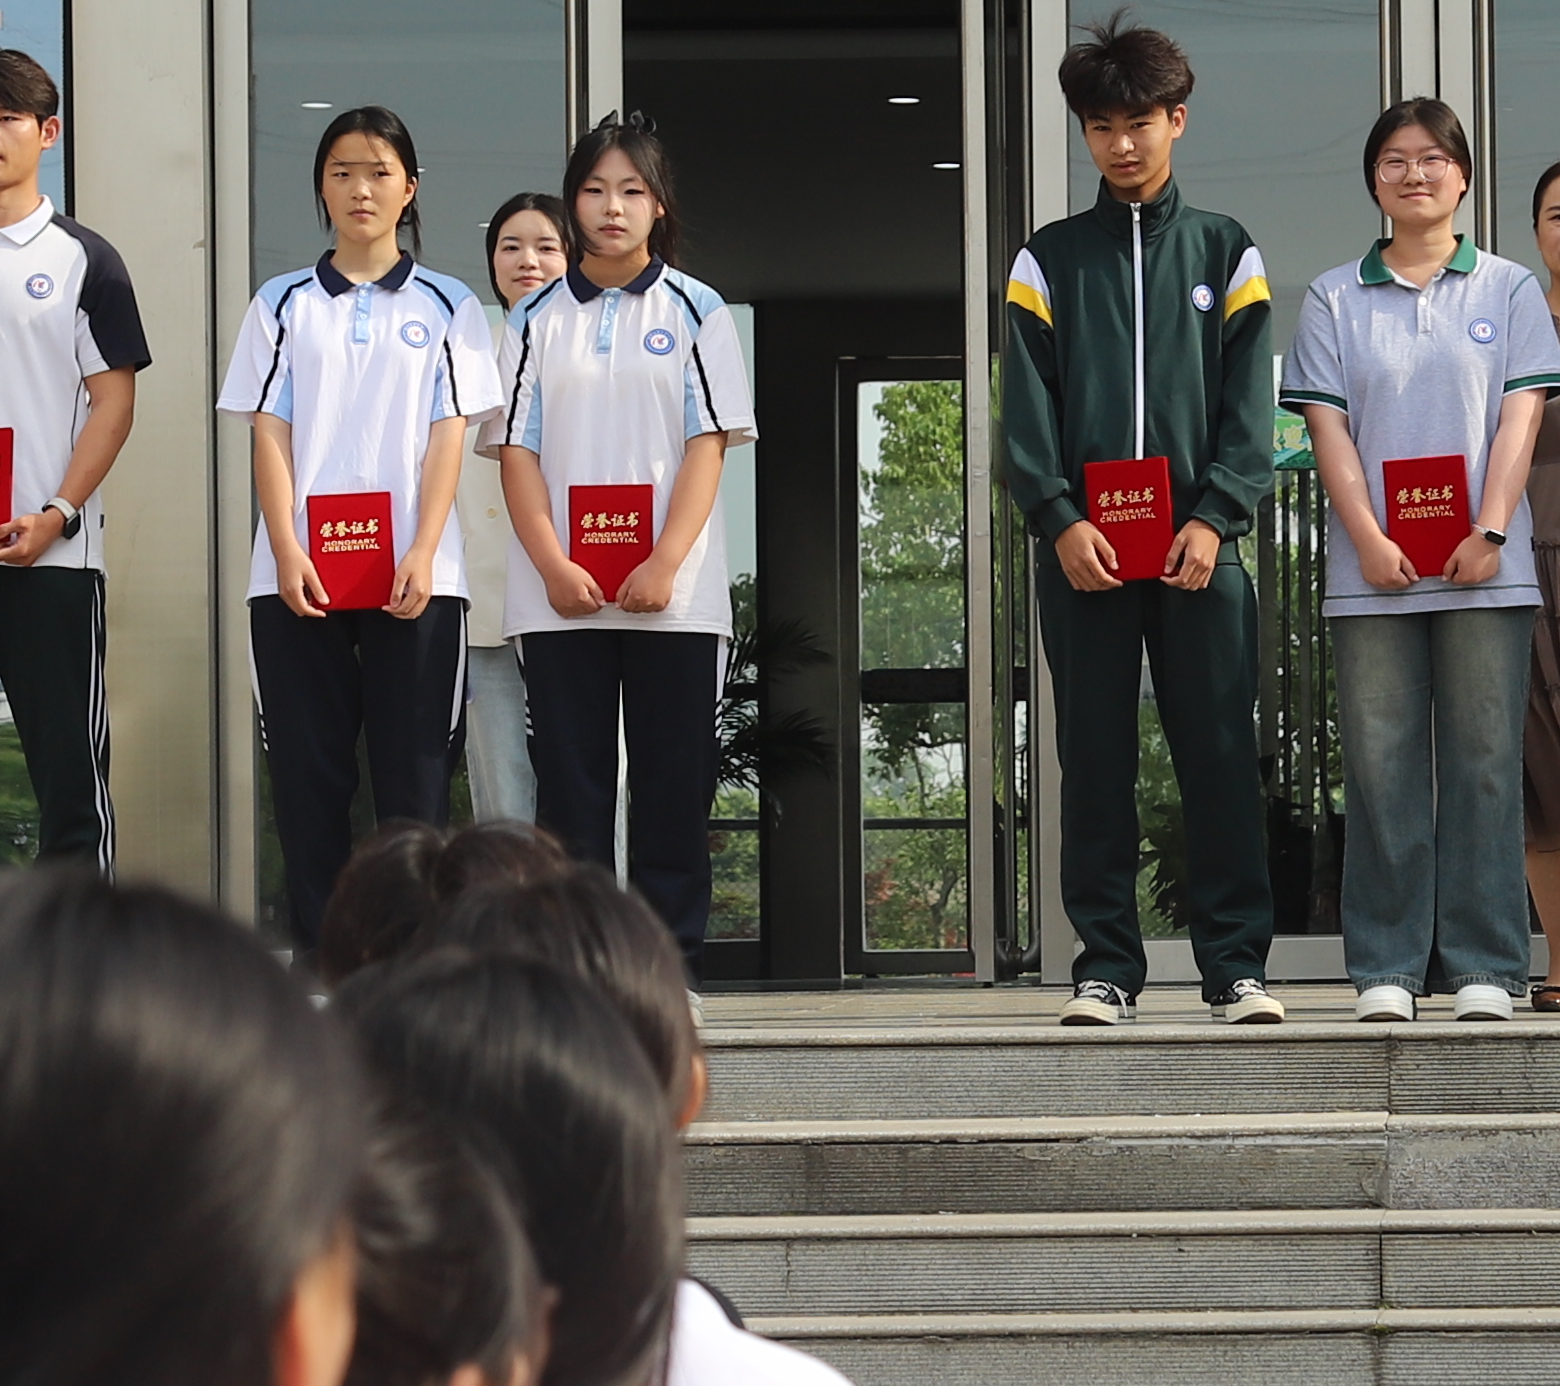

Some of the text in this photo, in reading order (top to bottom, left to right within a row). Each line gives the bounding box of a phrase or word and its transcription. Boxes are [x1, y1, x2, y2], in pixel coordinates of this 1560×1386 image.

[1097, 486, 1155, 509] 荣誉证书
[1395, 485, 1454, 506] 荣誉证书
[1102, 506, 1153, 518] HONORARY
[1397, 509, 1455, 520] CREDENTIAL
[1400, 504, 1452, 515] HONORARY
[580, 512, 639, 528] 荣誉证书
[1099, 512, 1157, 523] CREDENTIAL
[320, 518, 380, 538] 荣誉证书
[580, 536, 639, 544] CREDENTIAL
[584, 531, 636, 539] HONORARY
[321, 543, 381, 553] CREDENTIAL
[324, 537, 376, 549] HONORARY
